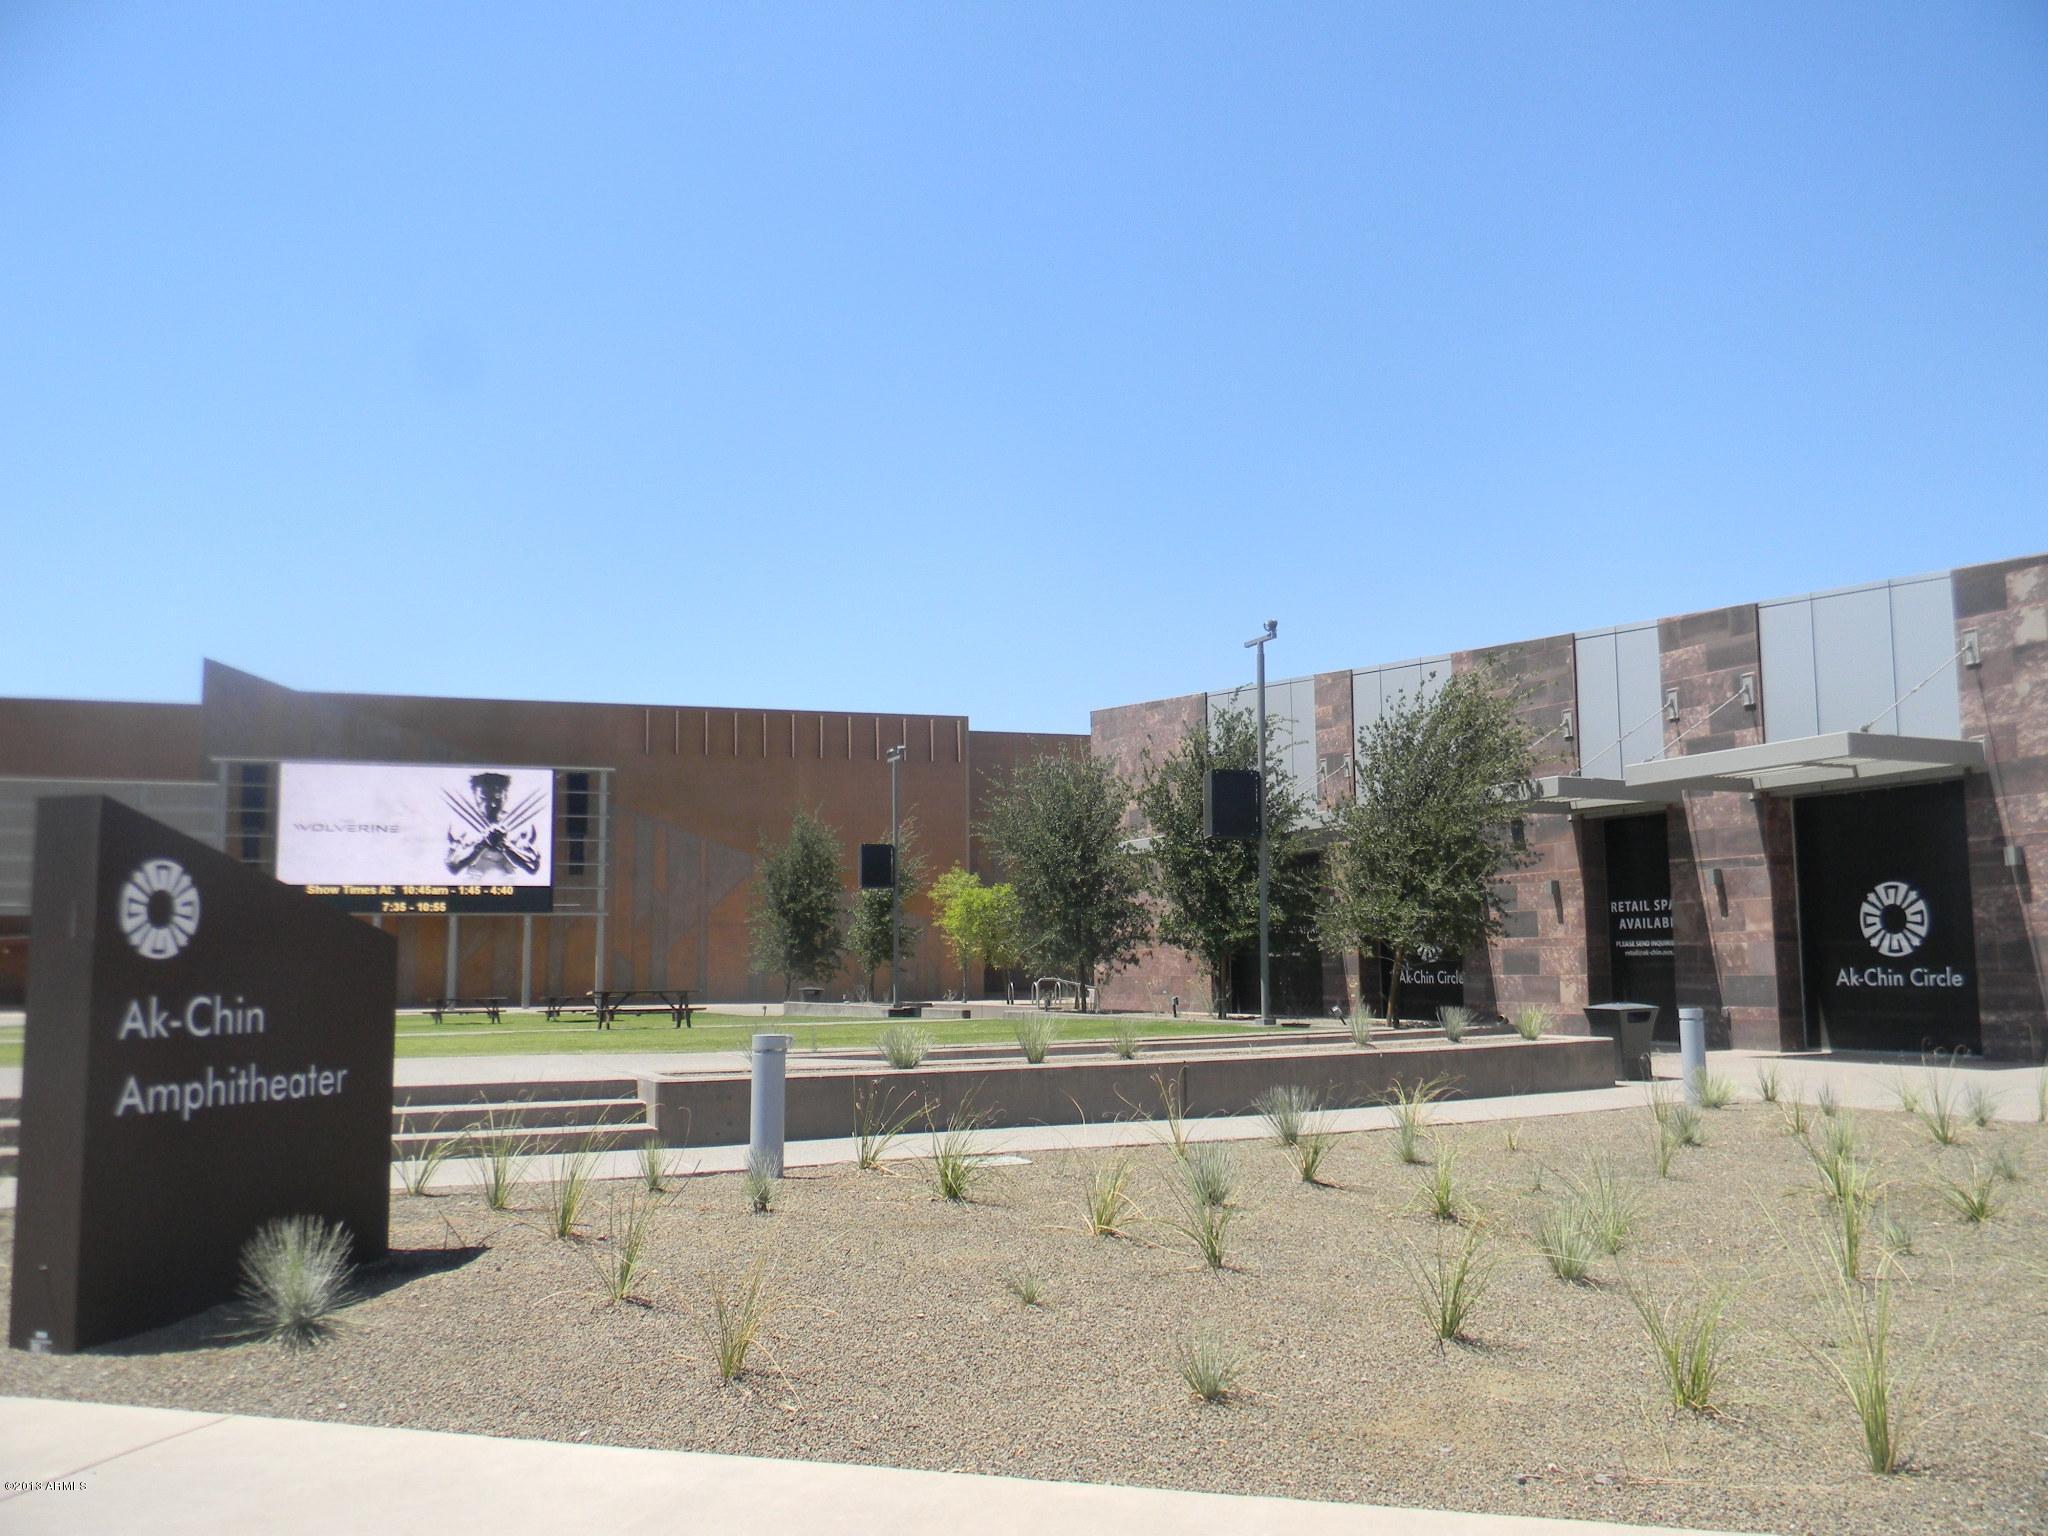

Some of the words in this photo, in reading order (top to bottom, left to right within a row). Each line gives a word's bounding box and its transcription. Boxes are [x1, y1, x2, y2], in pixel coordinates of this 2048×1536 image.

[293, 823, 400, 834] WOLVERINE
[306, 886, 339, 895] Show
[342, 886, 377, 895] Times
[402, 886, 449, 895] 10:45am
[459, 886, 481, 895] 1:45
[490, 886, 514, 895] 4:40
[382, 902, 407, 912] 7:35
[1611, 901, 1650, 912] RETAIL
[1400, 970, 1434, 984] Ak-Chin
[1437, 970, 1463, 984] Circle
[1836, 967, 1904, 987] Ak-Chin
[1910, 967, 1963, 987] Circle
[117, 995, 266, 1040] Ak-Chin
[114, 1062, 349, 1121] Amphitheater
